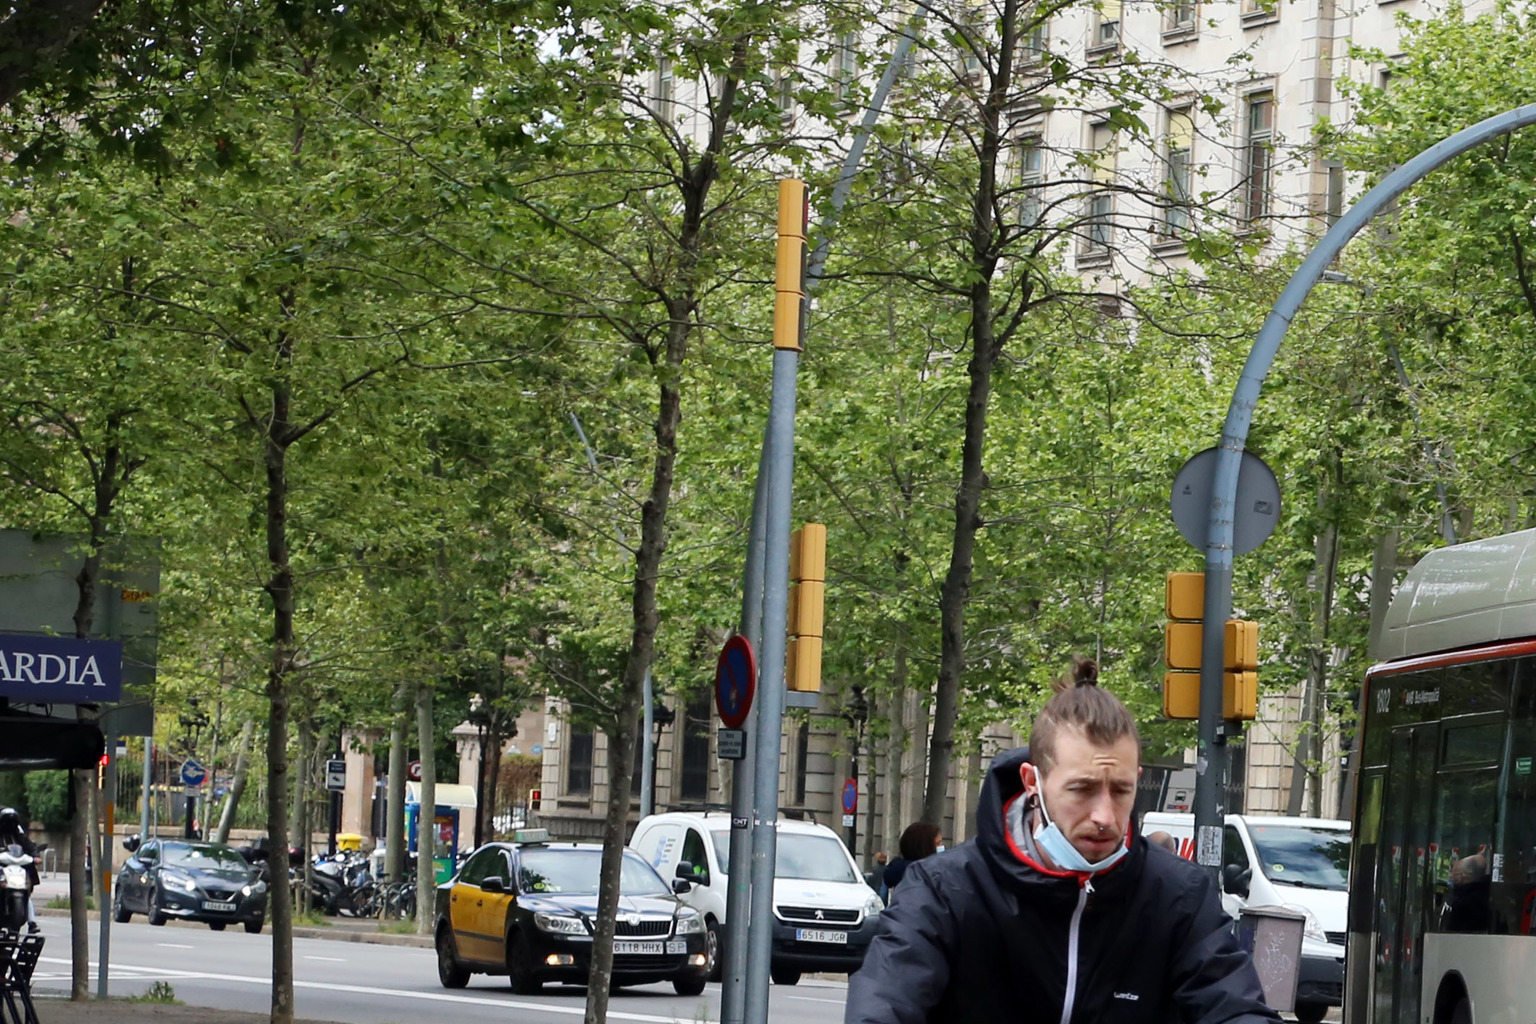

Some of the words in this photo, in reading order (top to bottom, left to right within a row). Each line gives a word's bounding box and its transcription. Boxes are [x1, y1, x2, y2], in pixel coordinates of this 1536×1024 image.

[802, 930, 825, 941] 6516
[829, 932, 846, 942] JGR
[614, 943, 639, 953] 6118
[642, 943, 661, 953] HHX
